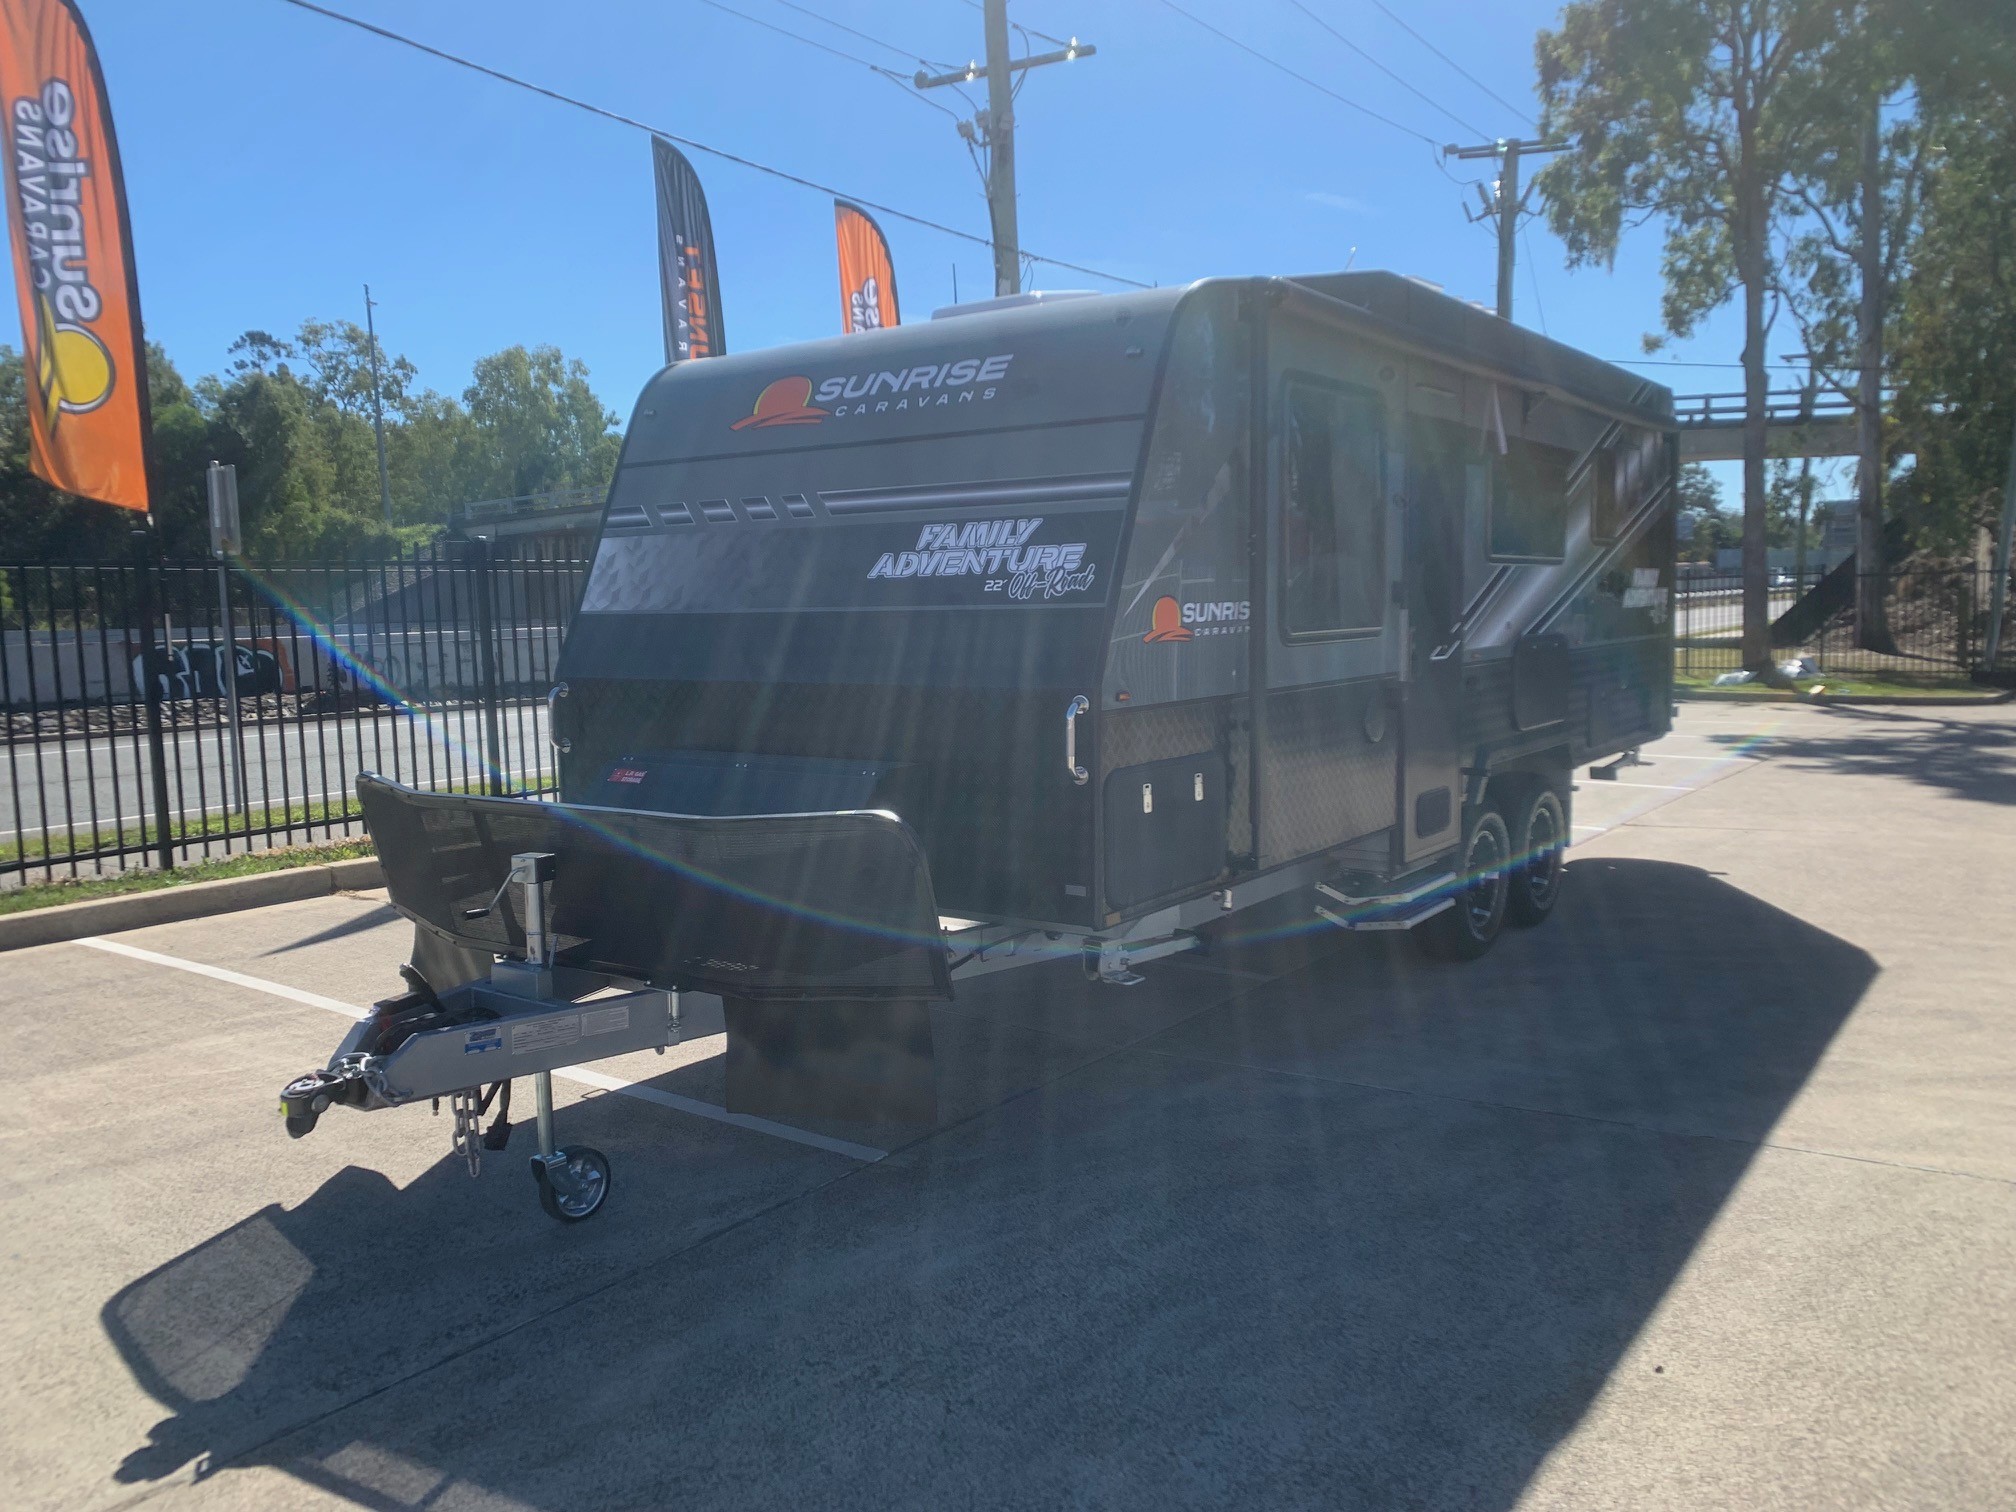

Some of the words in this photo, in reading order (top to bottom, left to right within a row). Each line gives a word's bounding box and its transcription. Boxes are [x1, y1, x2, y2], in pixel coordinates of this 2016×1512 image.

[814, 353, 1014, 402] SUNRISE
[834, 387, 997, 417] CARAVANS
[915, 517, 1044, 551] FAMILY
[866, 542, 1088, 579] ADVENTURE
[1007, 563, 1096, 600] Off-Road
[1182, 601, 1251, 623] SUNRIS
